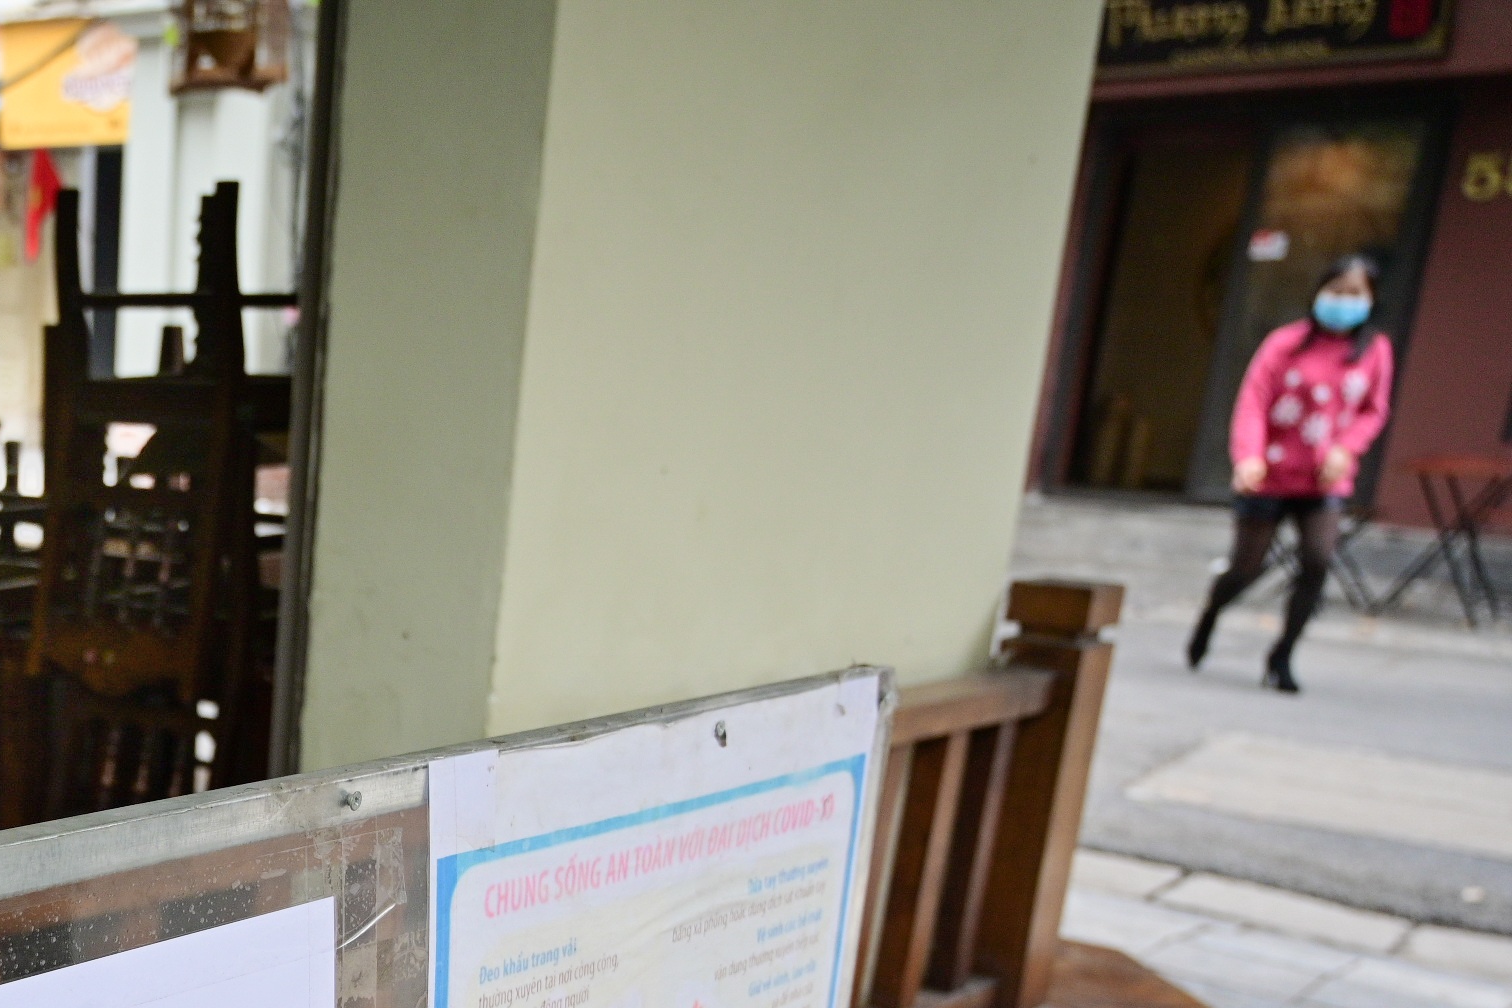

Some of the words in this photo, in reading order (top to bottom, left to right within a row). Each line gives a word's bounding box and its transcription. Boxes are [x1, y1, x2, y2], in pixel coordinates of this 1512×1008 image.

[484, 870, 548, 918] CHUNG
[553, 855, 601, 899] SỐNG
[606, 852, 630, 884] AN
[632, 836, 676, 876] TOÀN
[479, 966, 500, 984] Đeo
[502, 952, 529, 977] khẩu
[531, 948, 560, 968] trang
[515, 977, 542, 1000] xuyên
[558, 969, 572, 985] nơi
[574, 961, 595, 980] công
